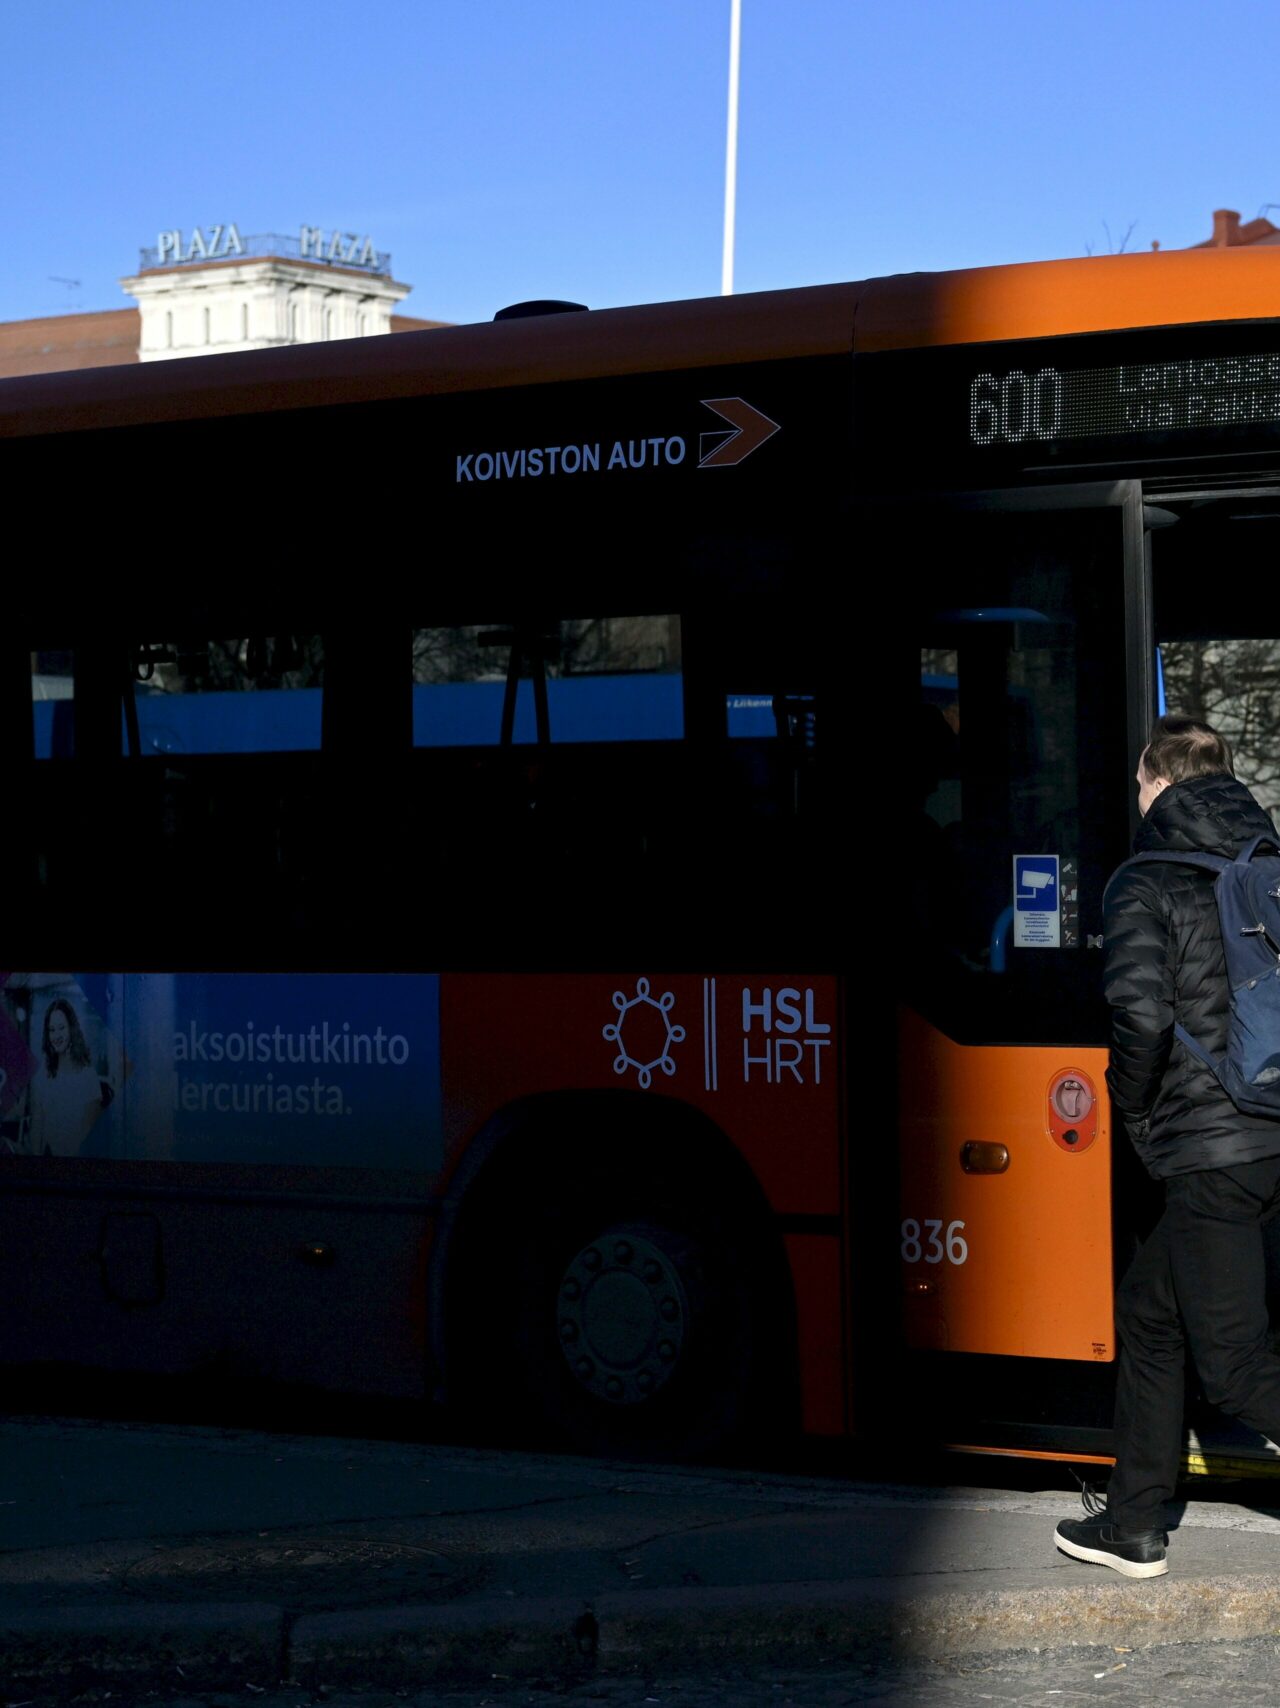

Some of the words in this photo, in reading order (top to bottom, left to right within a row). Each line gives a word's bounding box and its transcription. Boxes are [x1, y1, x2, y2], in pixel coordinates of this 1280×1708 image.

[158, 222, 245, 263] PLAZA
[970, 366, 1062, 444] 600
[1125, 401, 1174, 429] via
[456, 442, 600, 482] KOIVISTON
[607, 435, 686, 471] AUTO
[742, 987, 832, 1034] HSL
[174, 1020, 410, 1065] aksoistutkinto
[743, 1037, 832, 1085] HRT
[172, 1073, 353, 1115] ercuriasta.
[900, 1217, 968, 1266] 836
